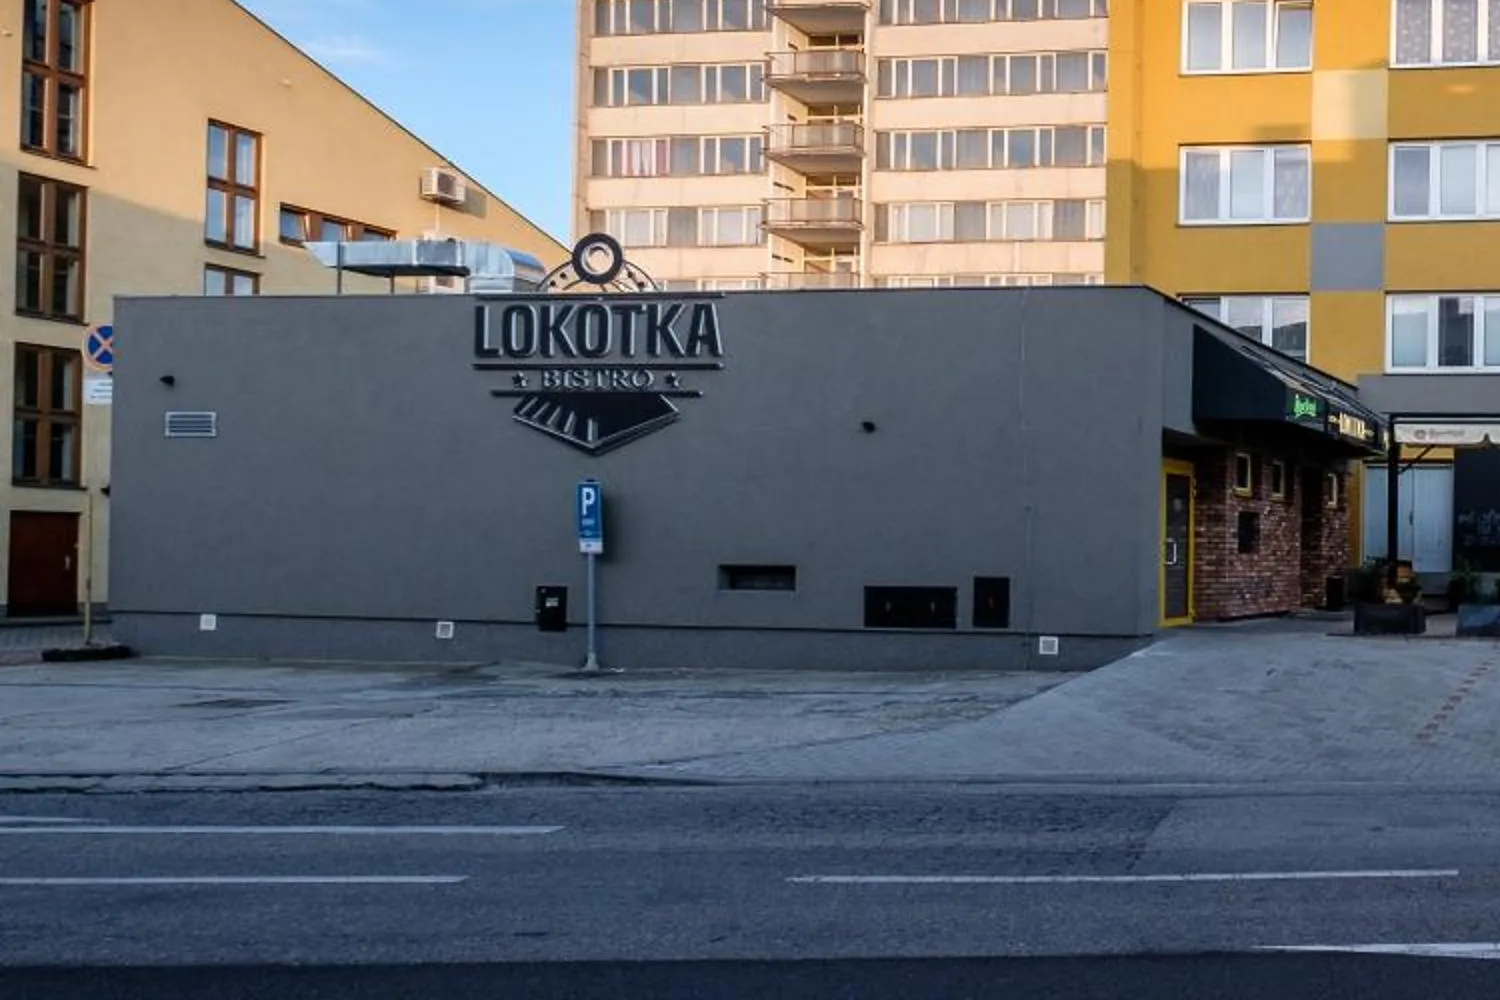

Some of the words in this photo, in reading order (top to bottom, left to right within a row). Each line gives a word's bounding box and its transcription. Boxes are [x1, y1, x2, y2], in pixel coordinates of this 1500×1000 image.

[473, 302, 723, 358] LOKOTKA
[542, 368, 655, 390] BISTRO
[582, 487, 596, 516] P
